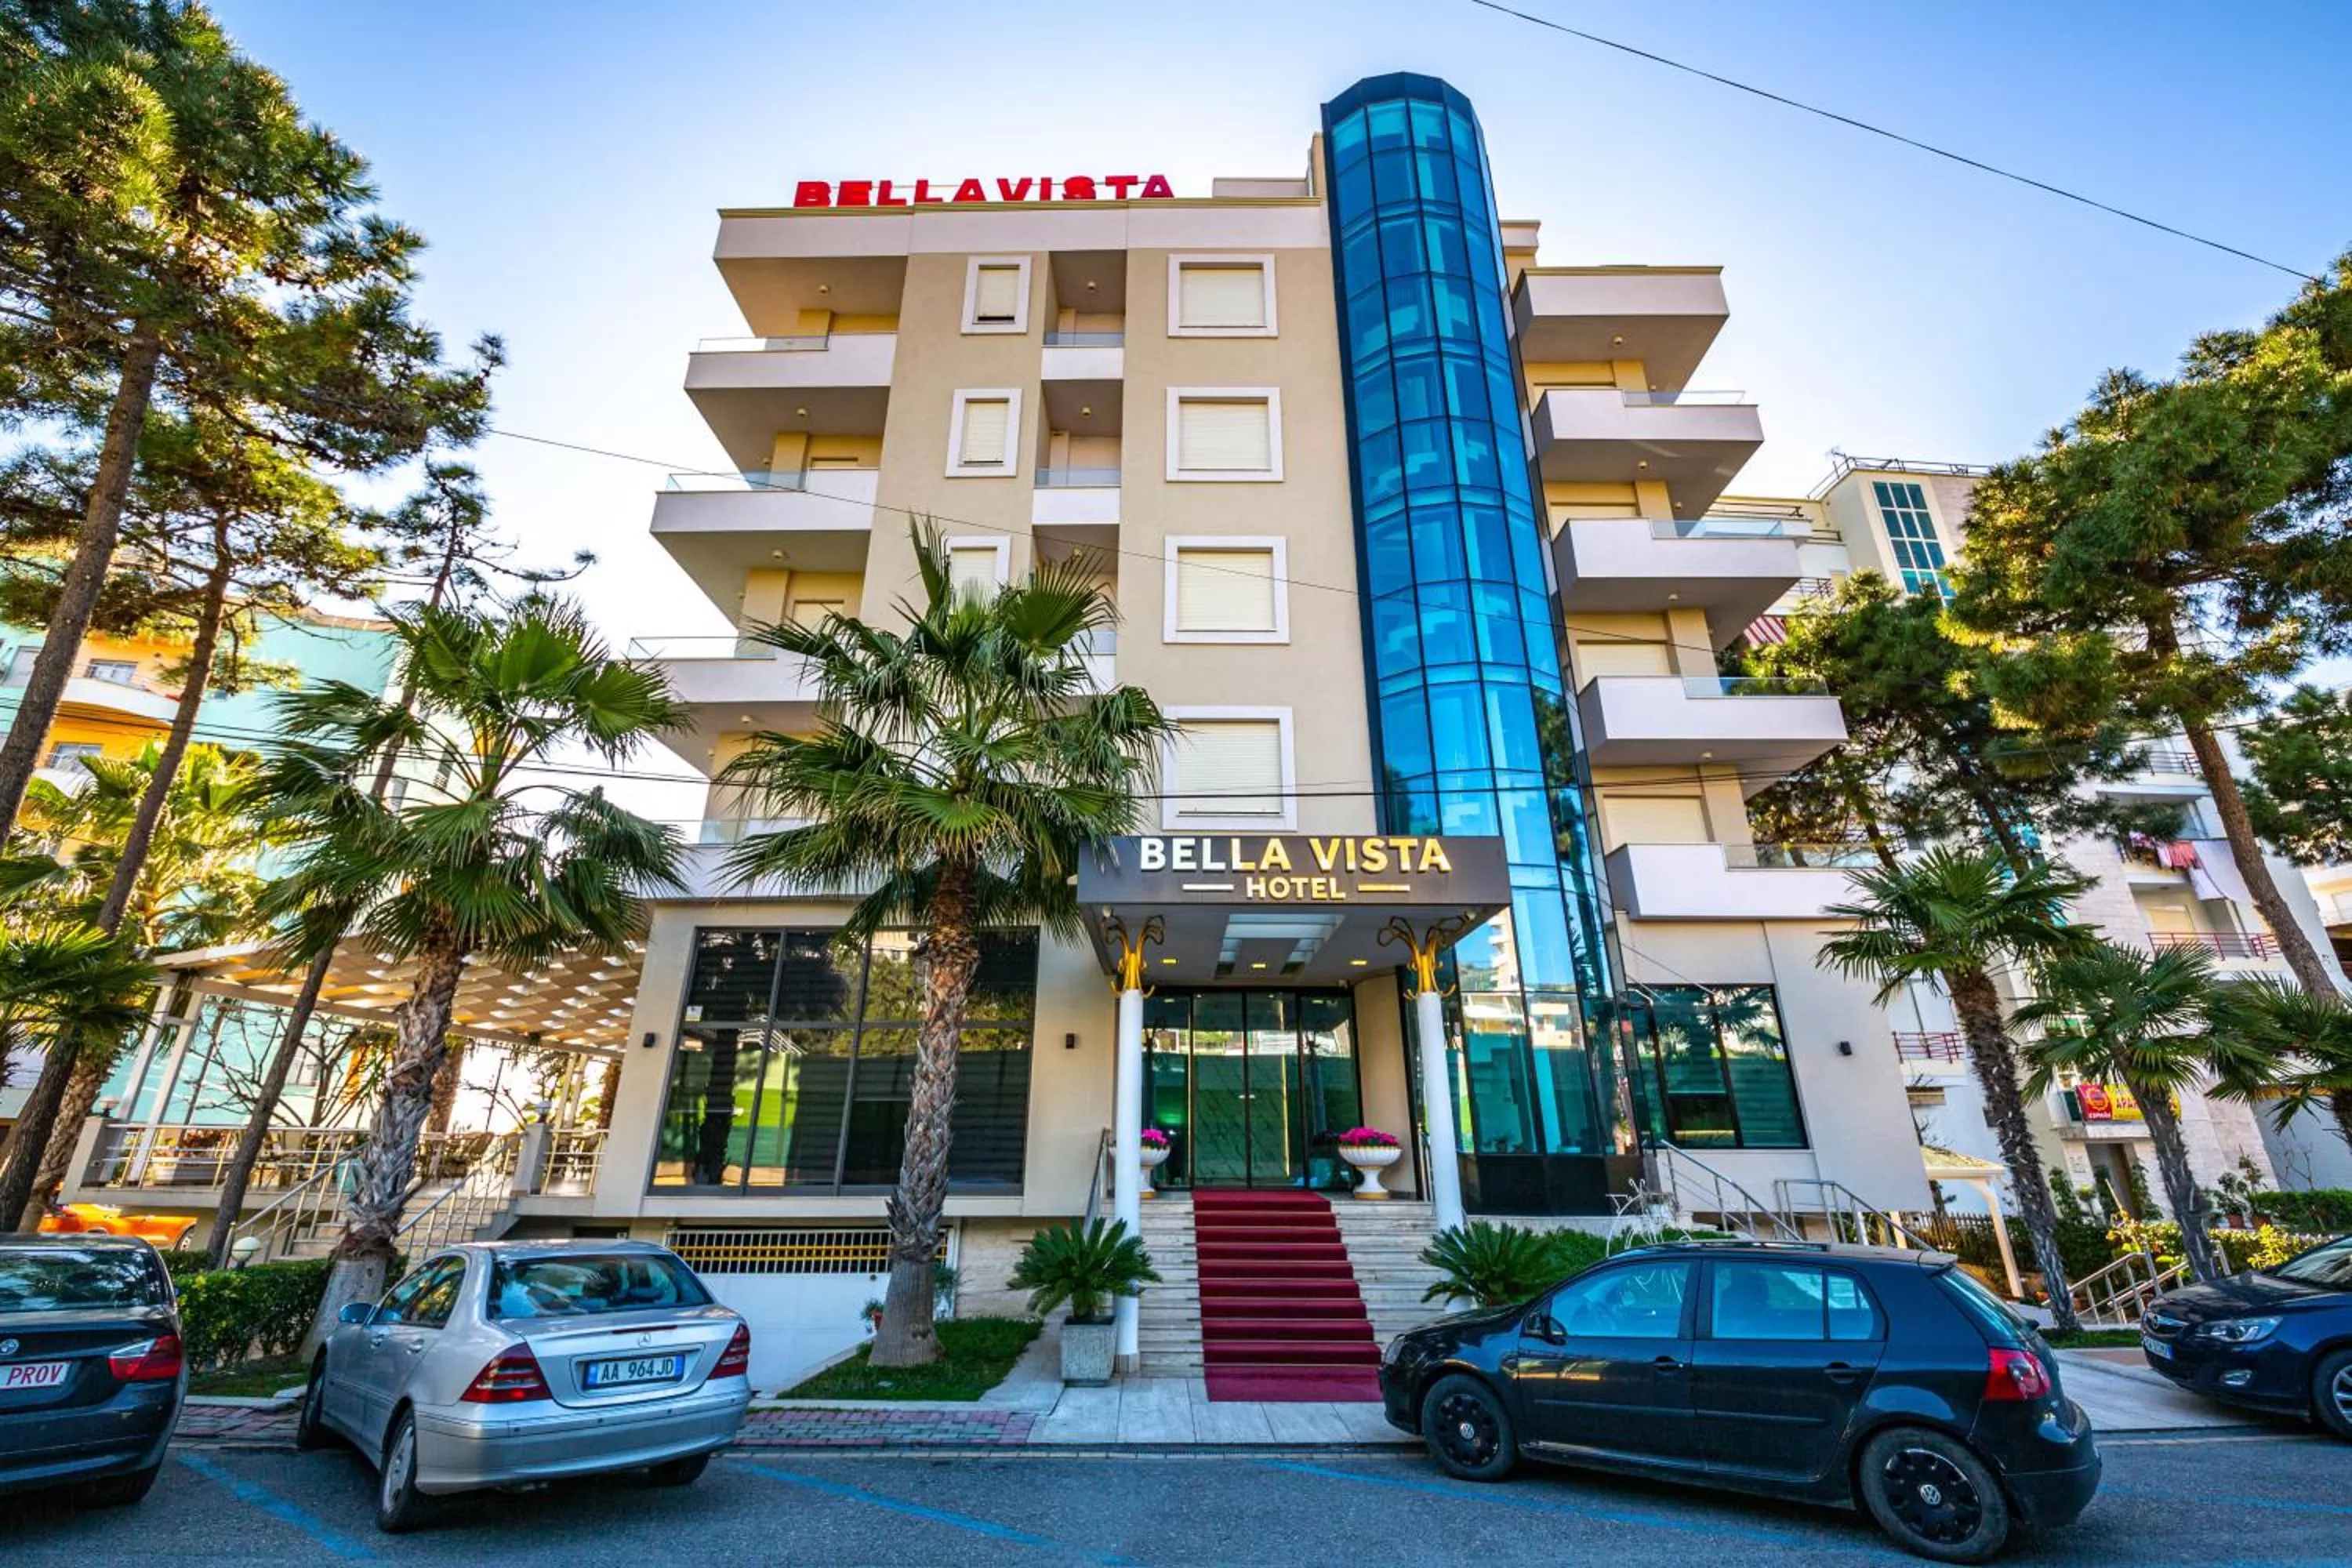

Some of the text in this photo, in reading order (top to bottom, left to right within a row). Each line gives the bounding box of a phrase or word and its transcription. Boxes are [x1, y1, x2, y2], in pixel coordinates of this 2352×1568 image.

[1140, 837, 1453, 873] BELLA VISTA
[1246, 877, 1346, 901] HOTEL
[7, 1365, 63, 1385] PROV
[602, 1359, 673, 1381] AA 964 JD
